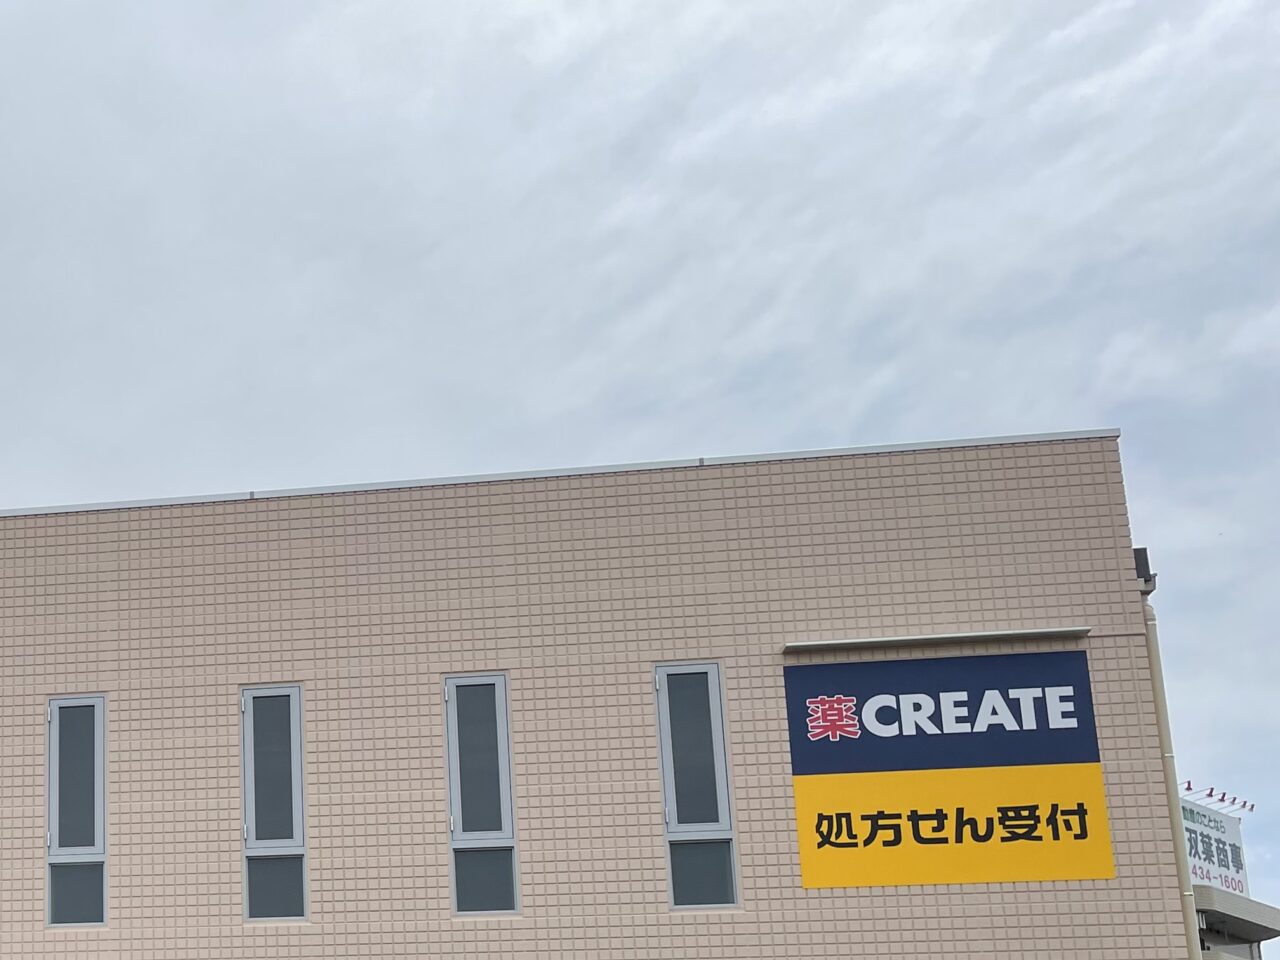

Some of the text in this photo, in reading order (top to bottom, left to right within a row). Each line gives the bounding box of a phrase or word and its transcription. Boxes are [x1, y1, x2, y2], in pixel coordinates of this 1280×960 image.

[861, 685, 1078, 738] CREATE
[815, 803, 1089, 850] 処方せん受付
[1191, 863, 1244, 894] 434-1600
